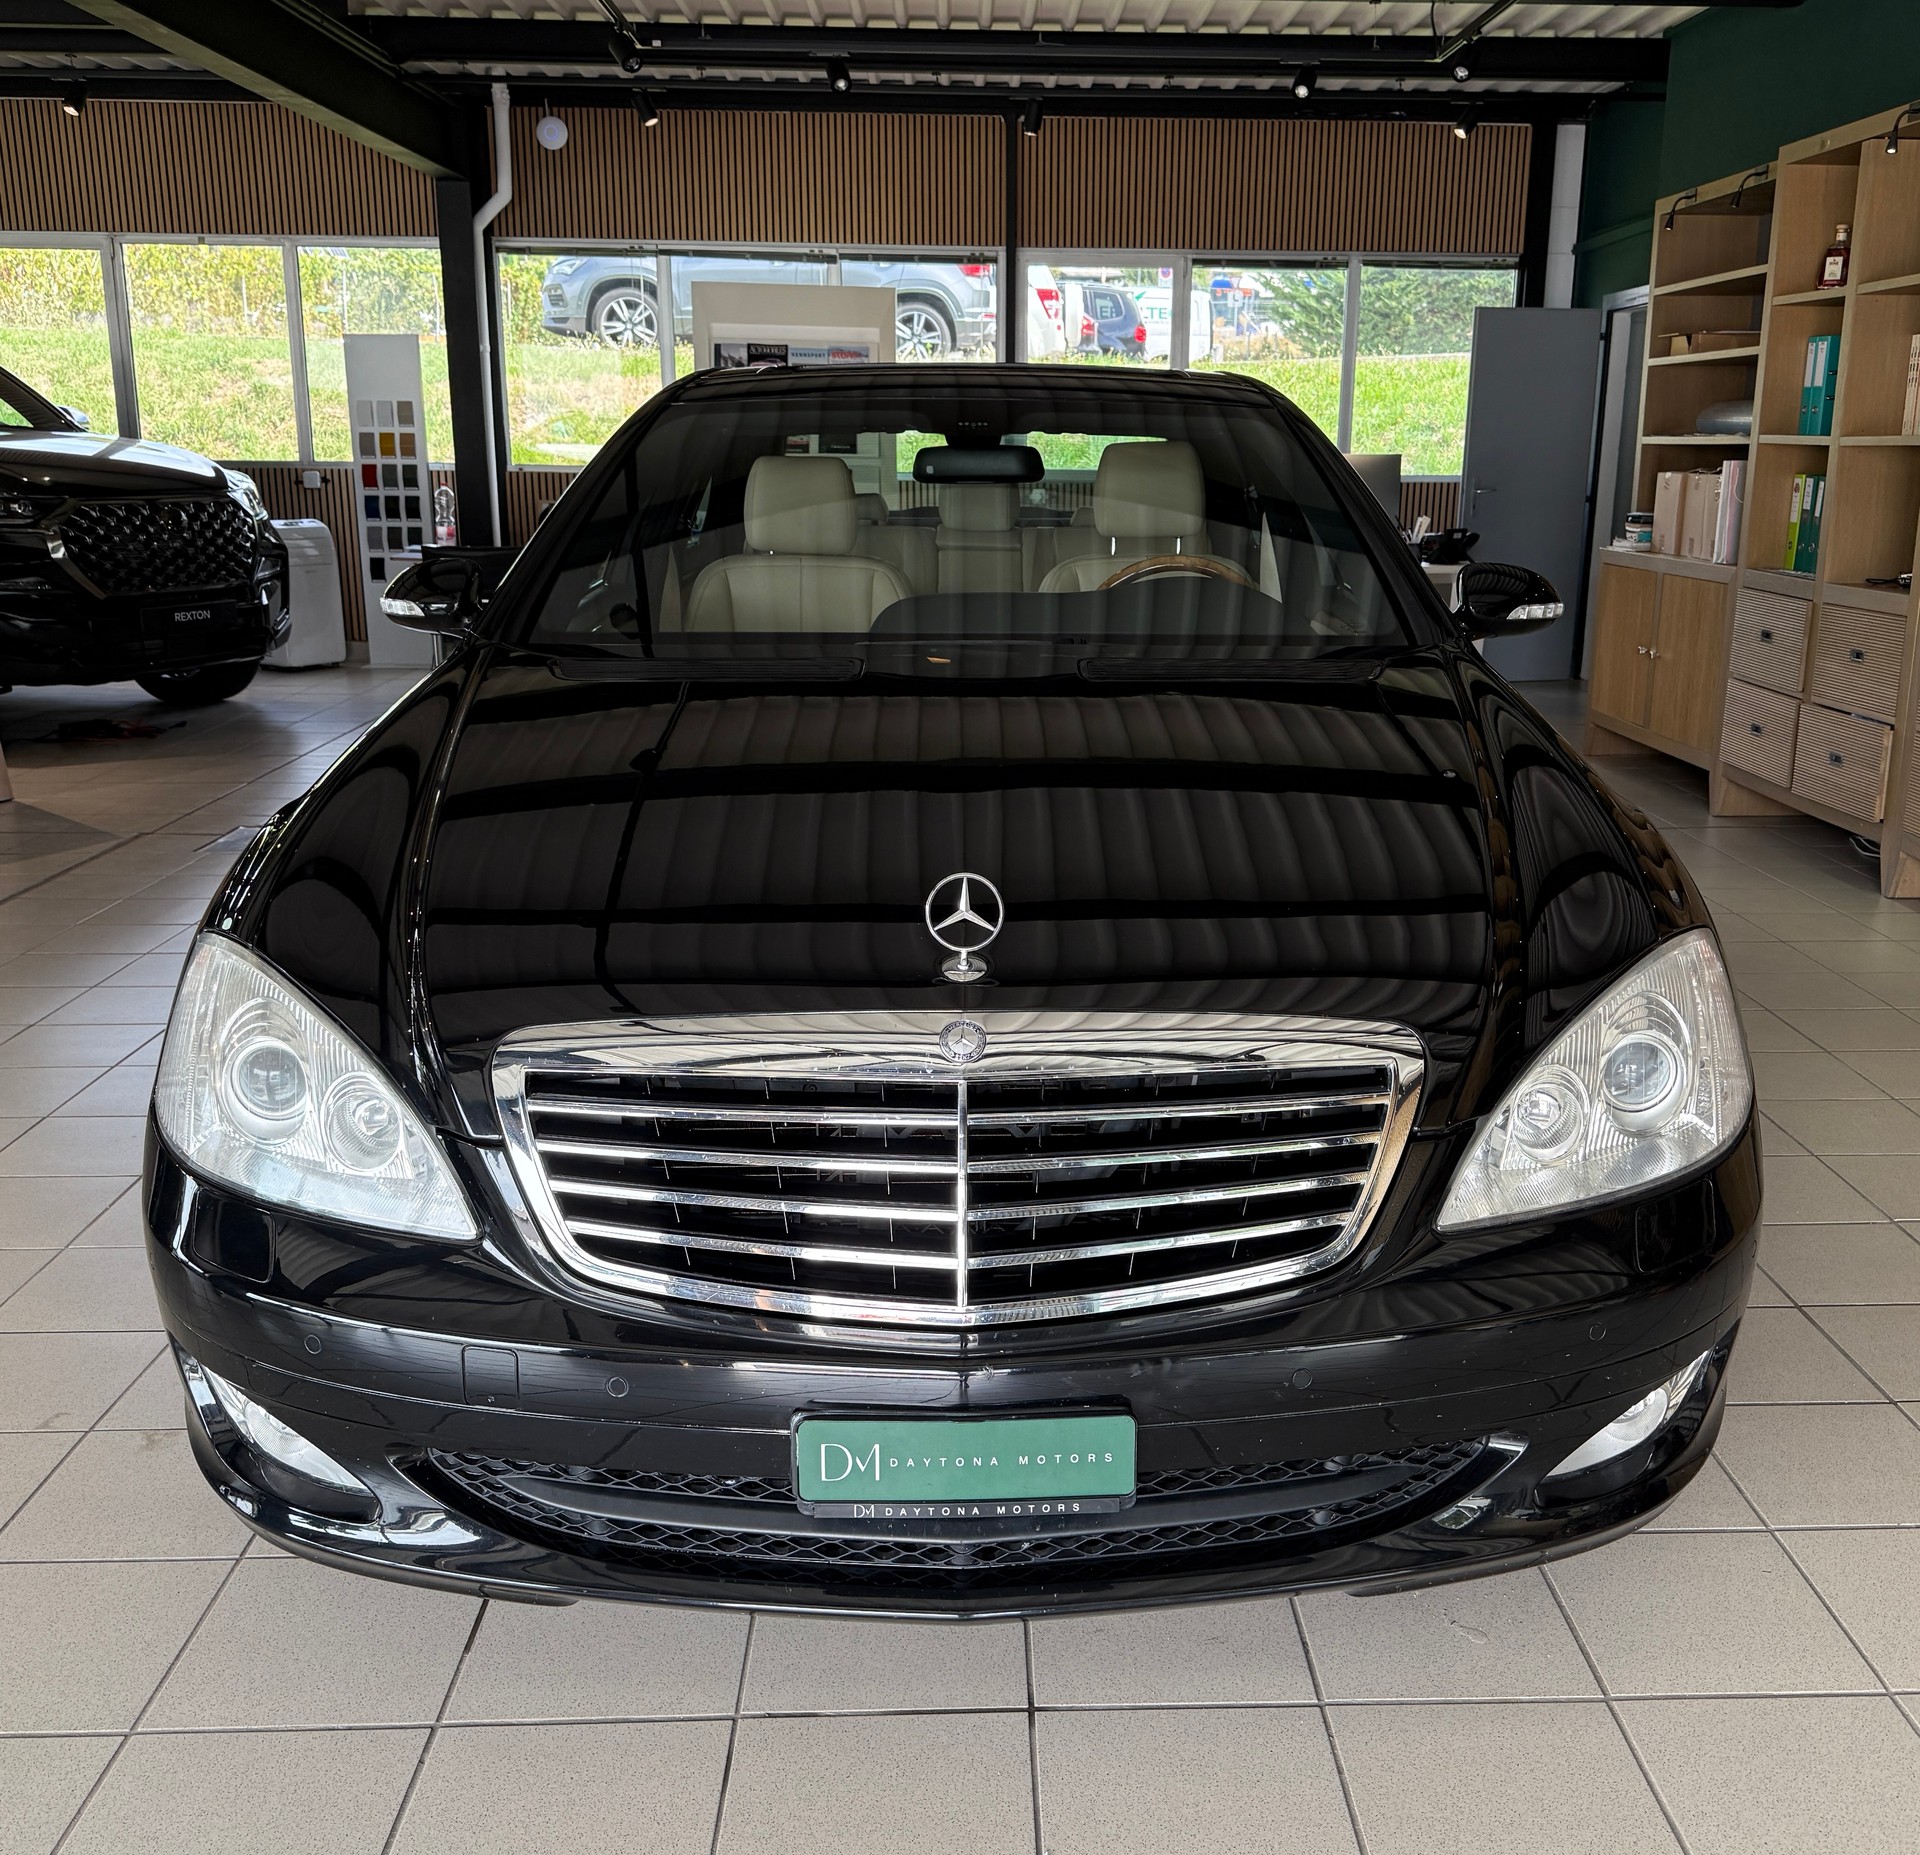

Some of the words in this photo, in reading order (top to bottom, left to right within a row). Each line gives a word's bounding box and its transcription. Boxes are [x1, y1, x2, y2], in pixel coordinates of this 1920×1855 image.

[174, 610, 211, 622] REXTON
[820, 1443, 880, 1482] DM
[890, 1456, 999, 1468] DAYTONA
[1018, 1452, 1114, 1465] MOTORS
[854, 1504, 875, 1519] DM
[885, 1506, 980, 1517] DAYTONA
[996, 1502, 1081, 1515] MOTORS
